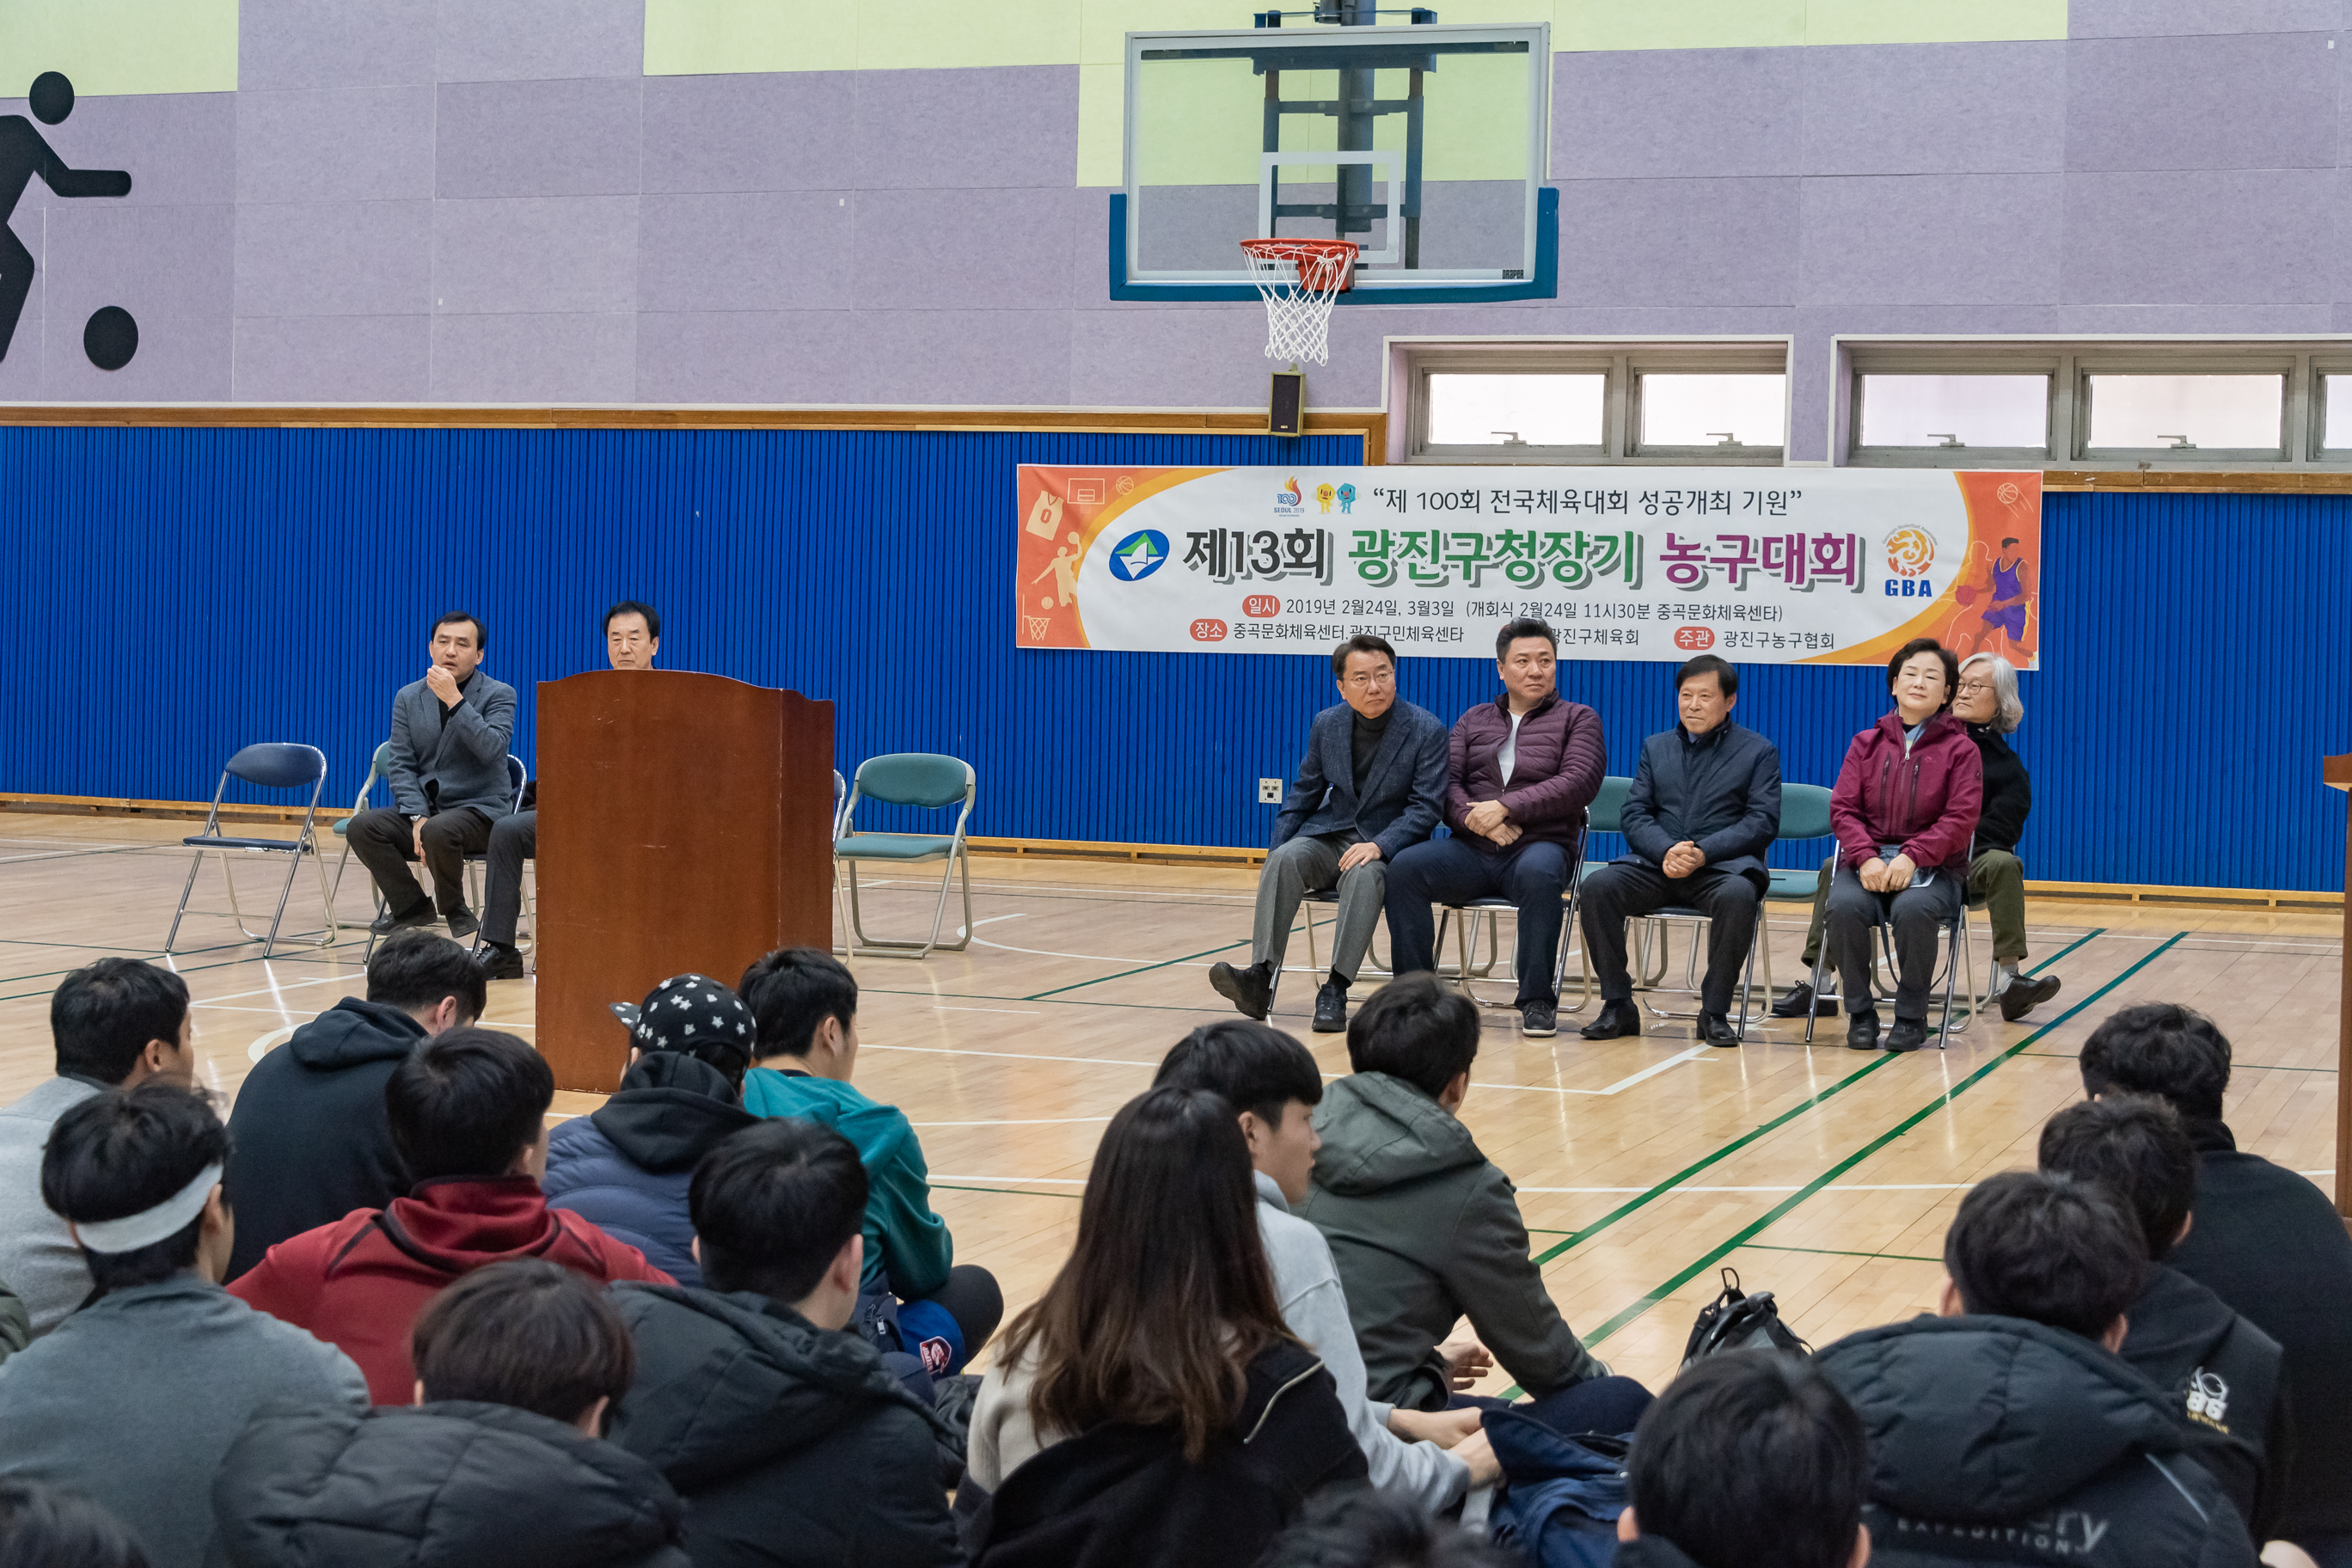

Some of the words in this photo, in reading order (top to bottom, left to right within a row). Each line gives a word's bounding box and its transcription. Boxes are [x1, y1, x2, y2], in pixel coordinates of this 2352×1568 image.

[1416, 488, 1480, 514] 100회
[1490, 488, 1627, 515] 전국체육대회
[1638, 489, 1731, 516] 성공개최
[1182, 527, 1326, 580] 제13회
[1348, 528, 1635, 584] 광진구청장기
[1659, 531, 1857, 588] 농구대회
[1884, 579, 1932, 597] GBA
[1247, 597, 1276, 616] 일시
[1286, 598, 1335, 616] 2019년
[1341, 599, 1401, 617] 2월24일,
[1407, 600, 1454, 617] 3월3일
[1466, 600, 1514, 618] (개회식
[1520, 602, 1577, 619] 2월24일
[1583, 603, 1651, 620] 11시30분
[1657, 603, 1783, 622] 중곡문화체육센타)
[1195, 622, 1223, 639] 장소
[1679, 630, 1711, 647] 주관
[1723, 631, 1834, 650] 광진구농구협회
